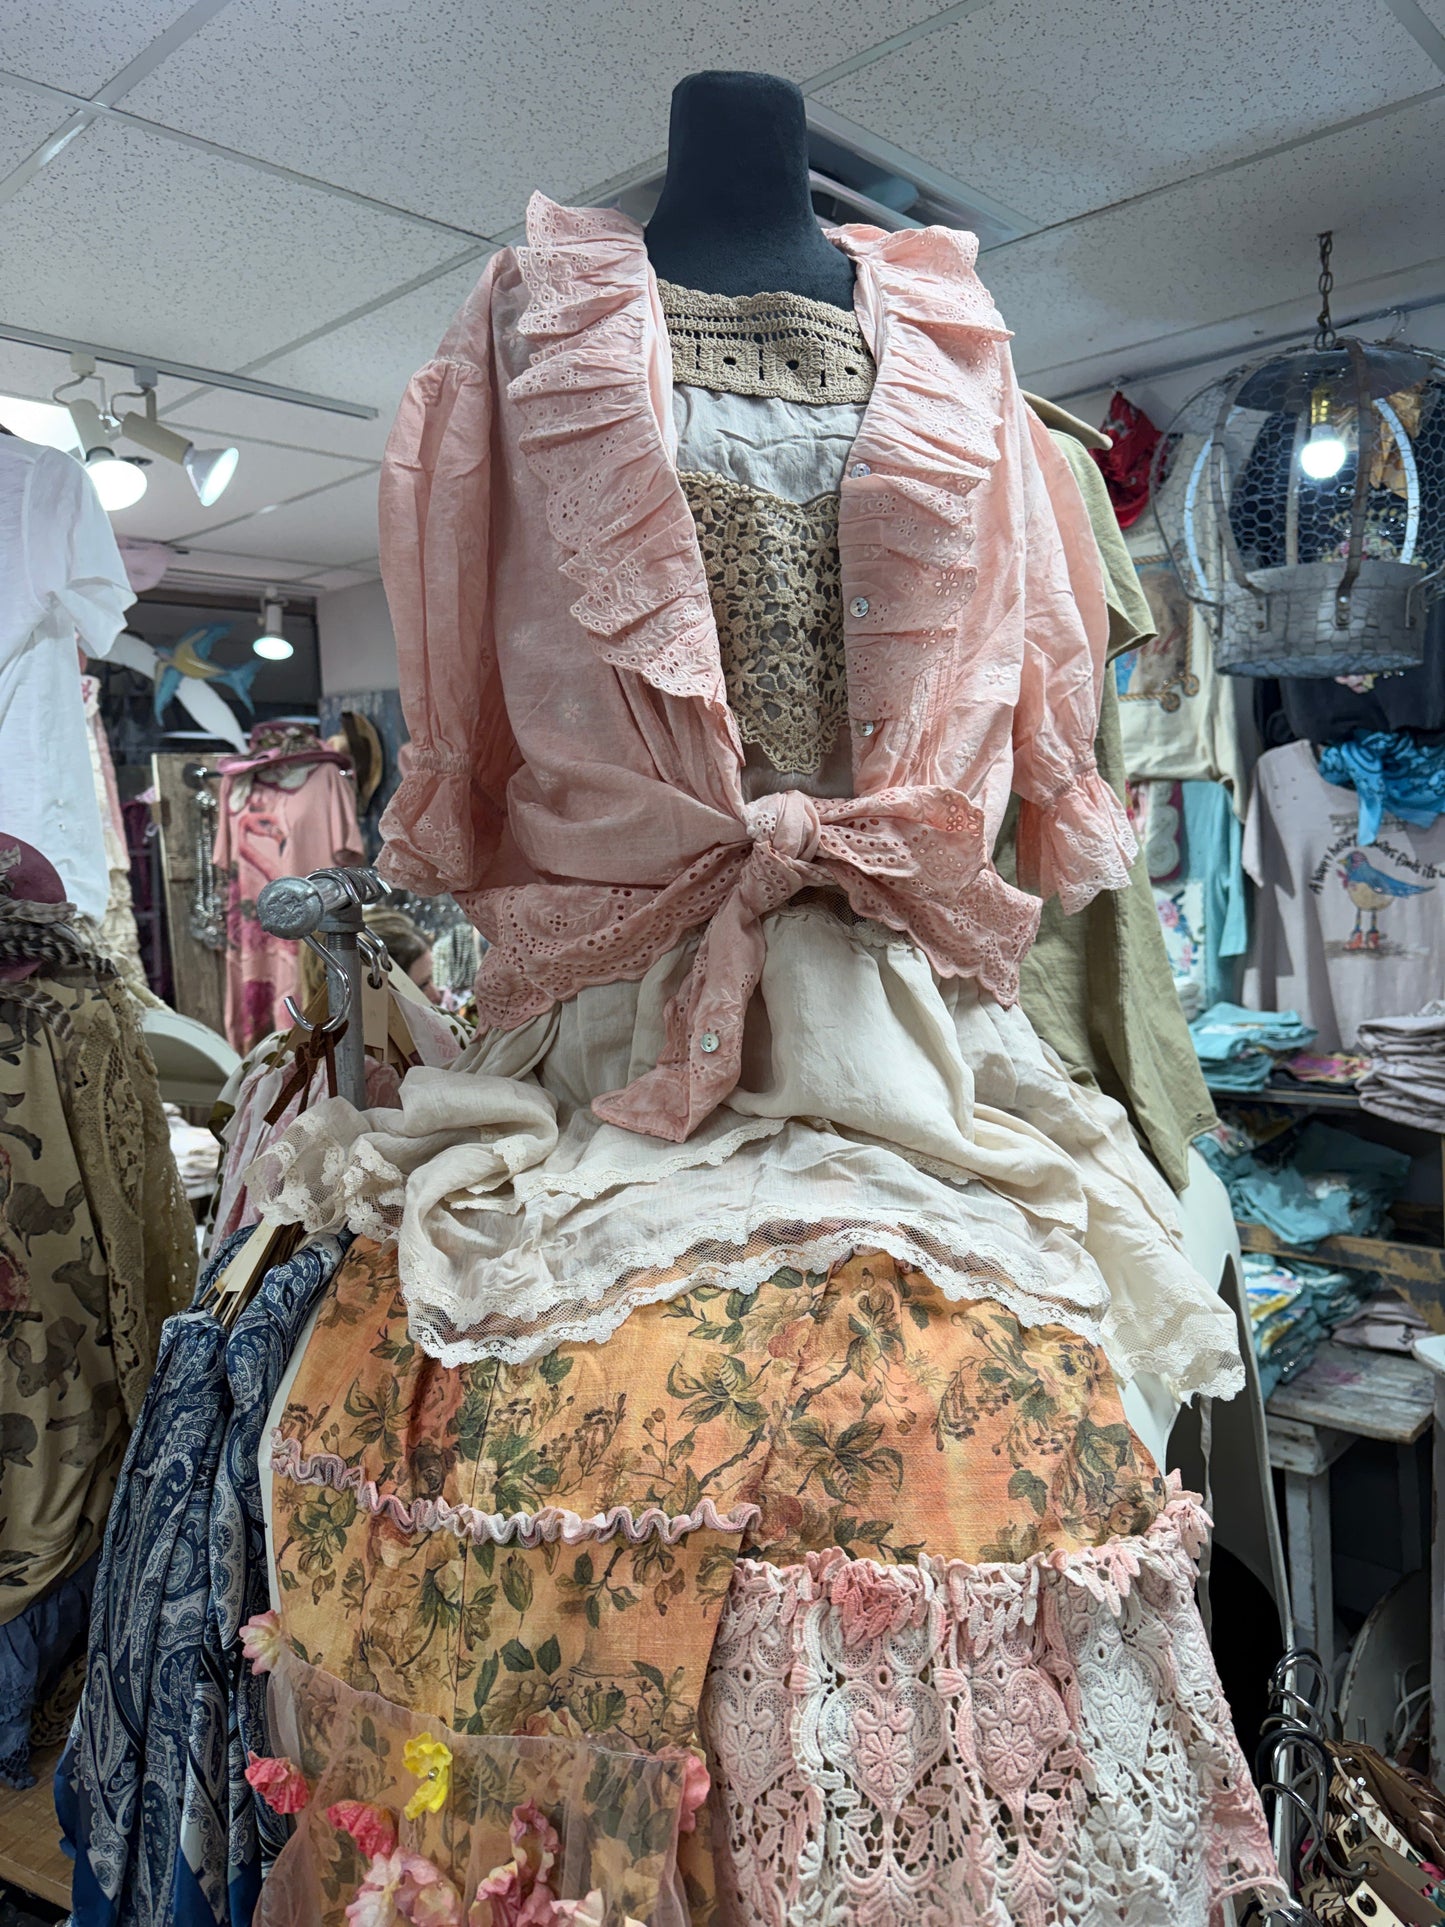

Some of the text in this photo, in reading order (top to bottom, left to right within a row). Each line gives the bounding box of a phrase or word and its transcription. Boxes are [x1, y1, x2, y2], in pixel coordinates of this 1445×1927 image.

[1308, 883, 1324, 895] A
[1327, 834, 1357, 856] heart
[1395, 852, 1421, 874] finds
